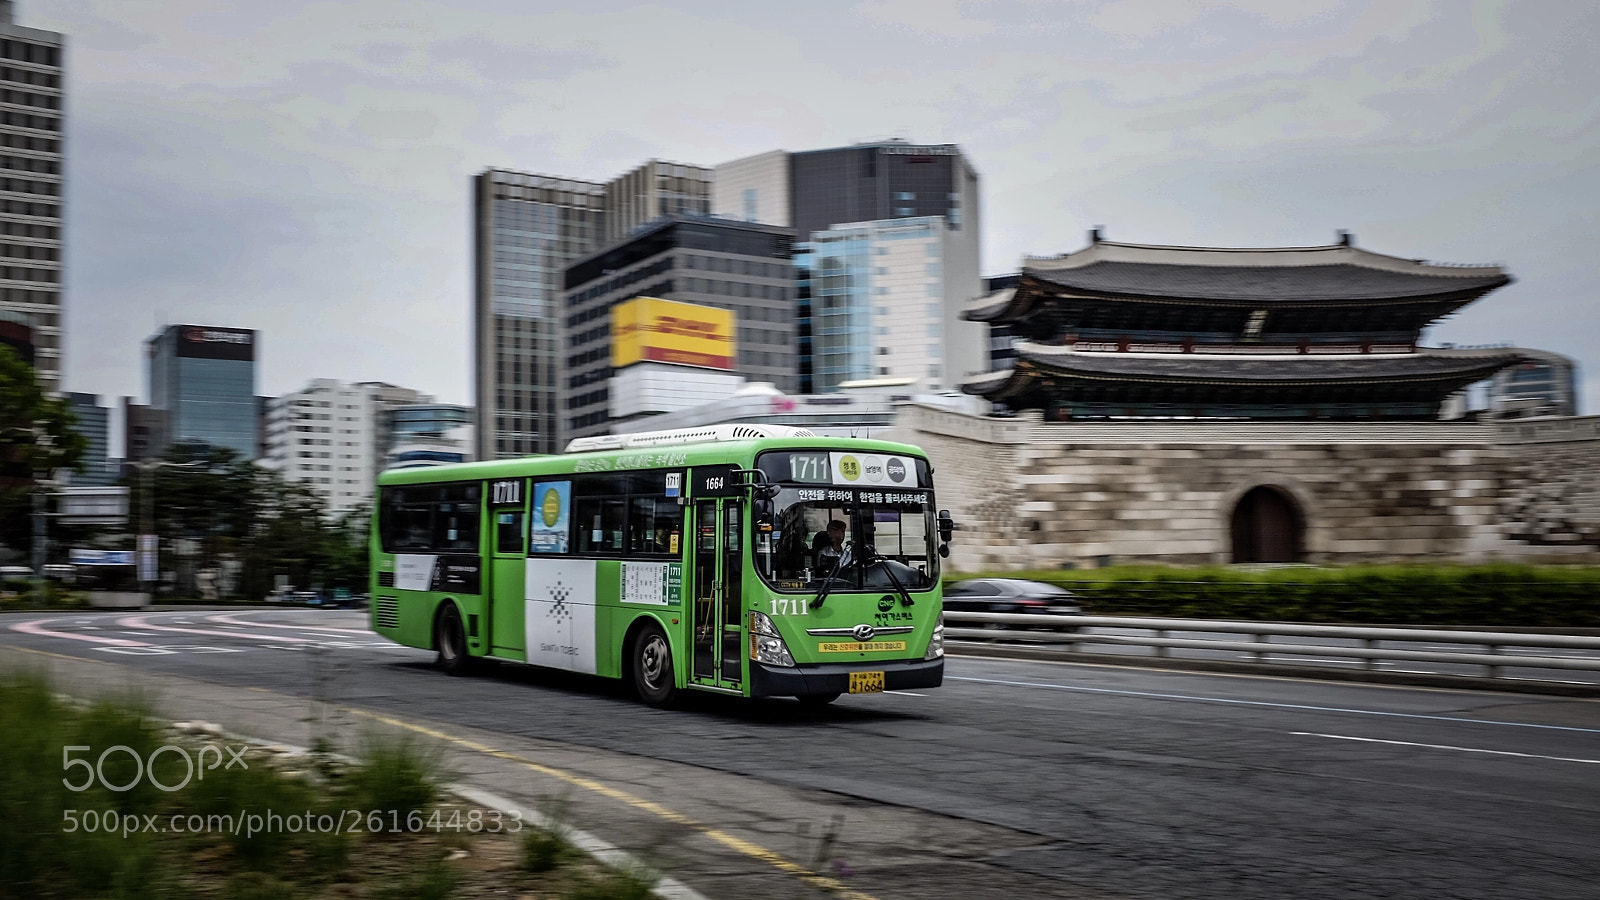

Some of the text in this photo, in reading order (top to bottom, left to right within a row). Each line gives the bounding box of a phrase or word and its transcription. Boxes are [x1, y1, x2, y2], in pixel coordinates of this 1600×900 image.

[789, 455, 828, 480] 1711
[667, 475, 679, 486] 1711
[705, 476, 724, 490] 1664
[492, 480, 521, 504] 1711
[798, 489, 825, 501] 안전을
[827, 490, 854, 502] 위하여
[859, 491, 884, 503] 한걸음
[670, 566, 681, 576] 1711
[769, 598, 809, 616] 1711
